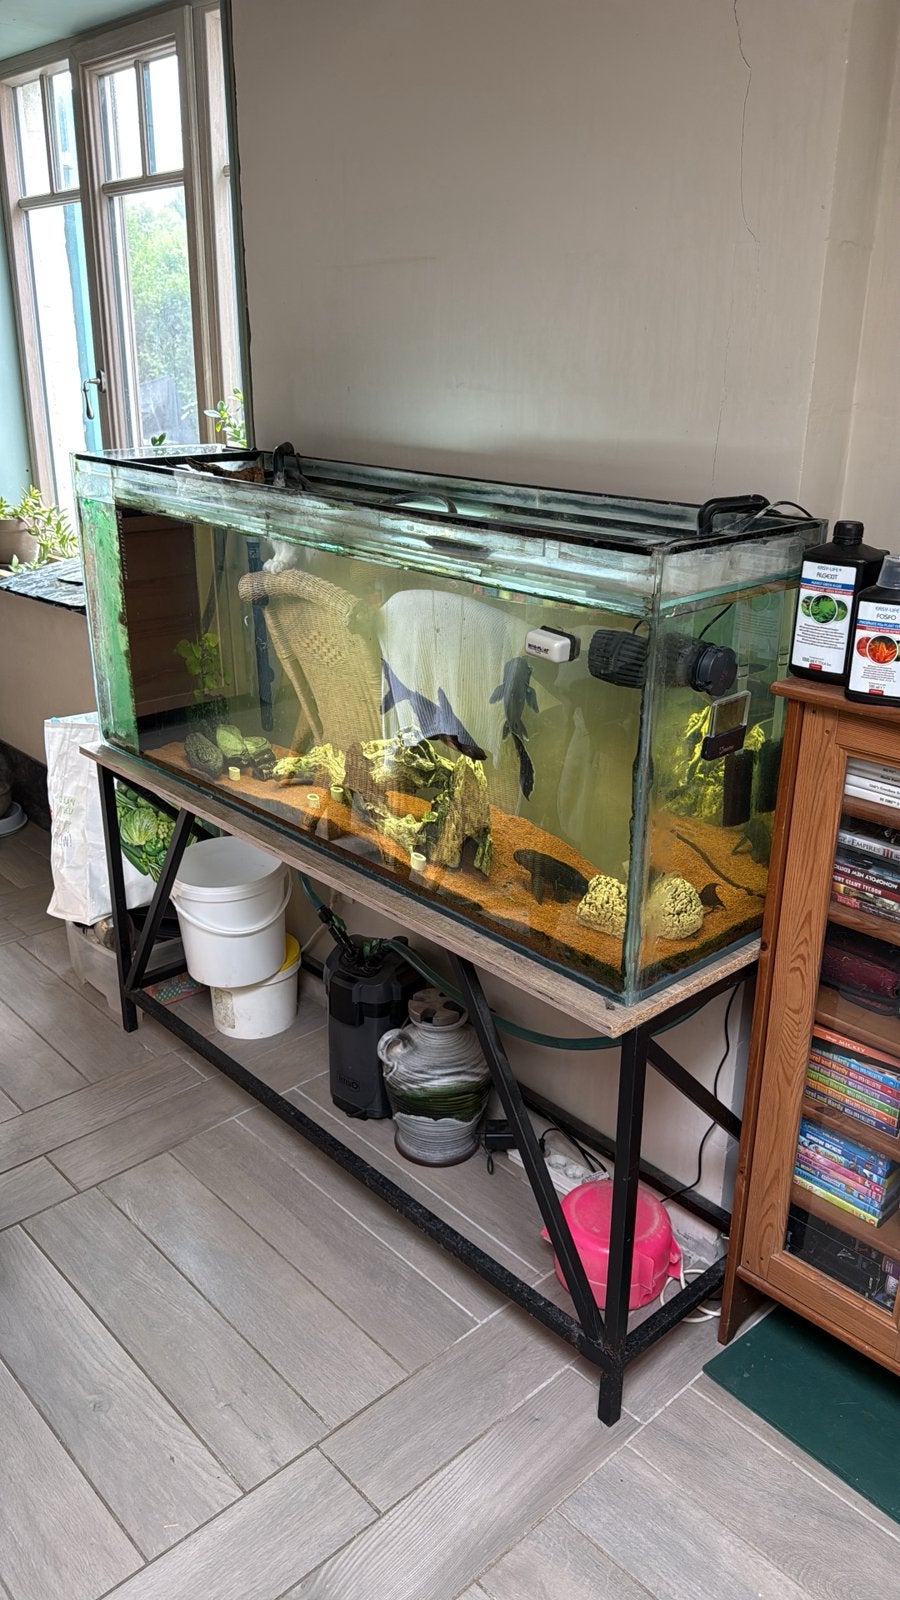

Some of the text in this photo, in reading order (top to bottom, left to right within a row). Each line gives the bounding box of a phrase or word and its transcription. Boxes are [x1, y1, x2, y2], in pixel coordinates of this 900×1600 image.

[851, 838, 881, 854] EMPIRES
[882, 847, 894, 859] III
[851, 870, 865, 878] NEW
[865, 874, 898, 890] MONOPOLY
[838, 1040, 866, 1053] MICKEY
[806, 1132, 842, 1154] SNOW DOGS
